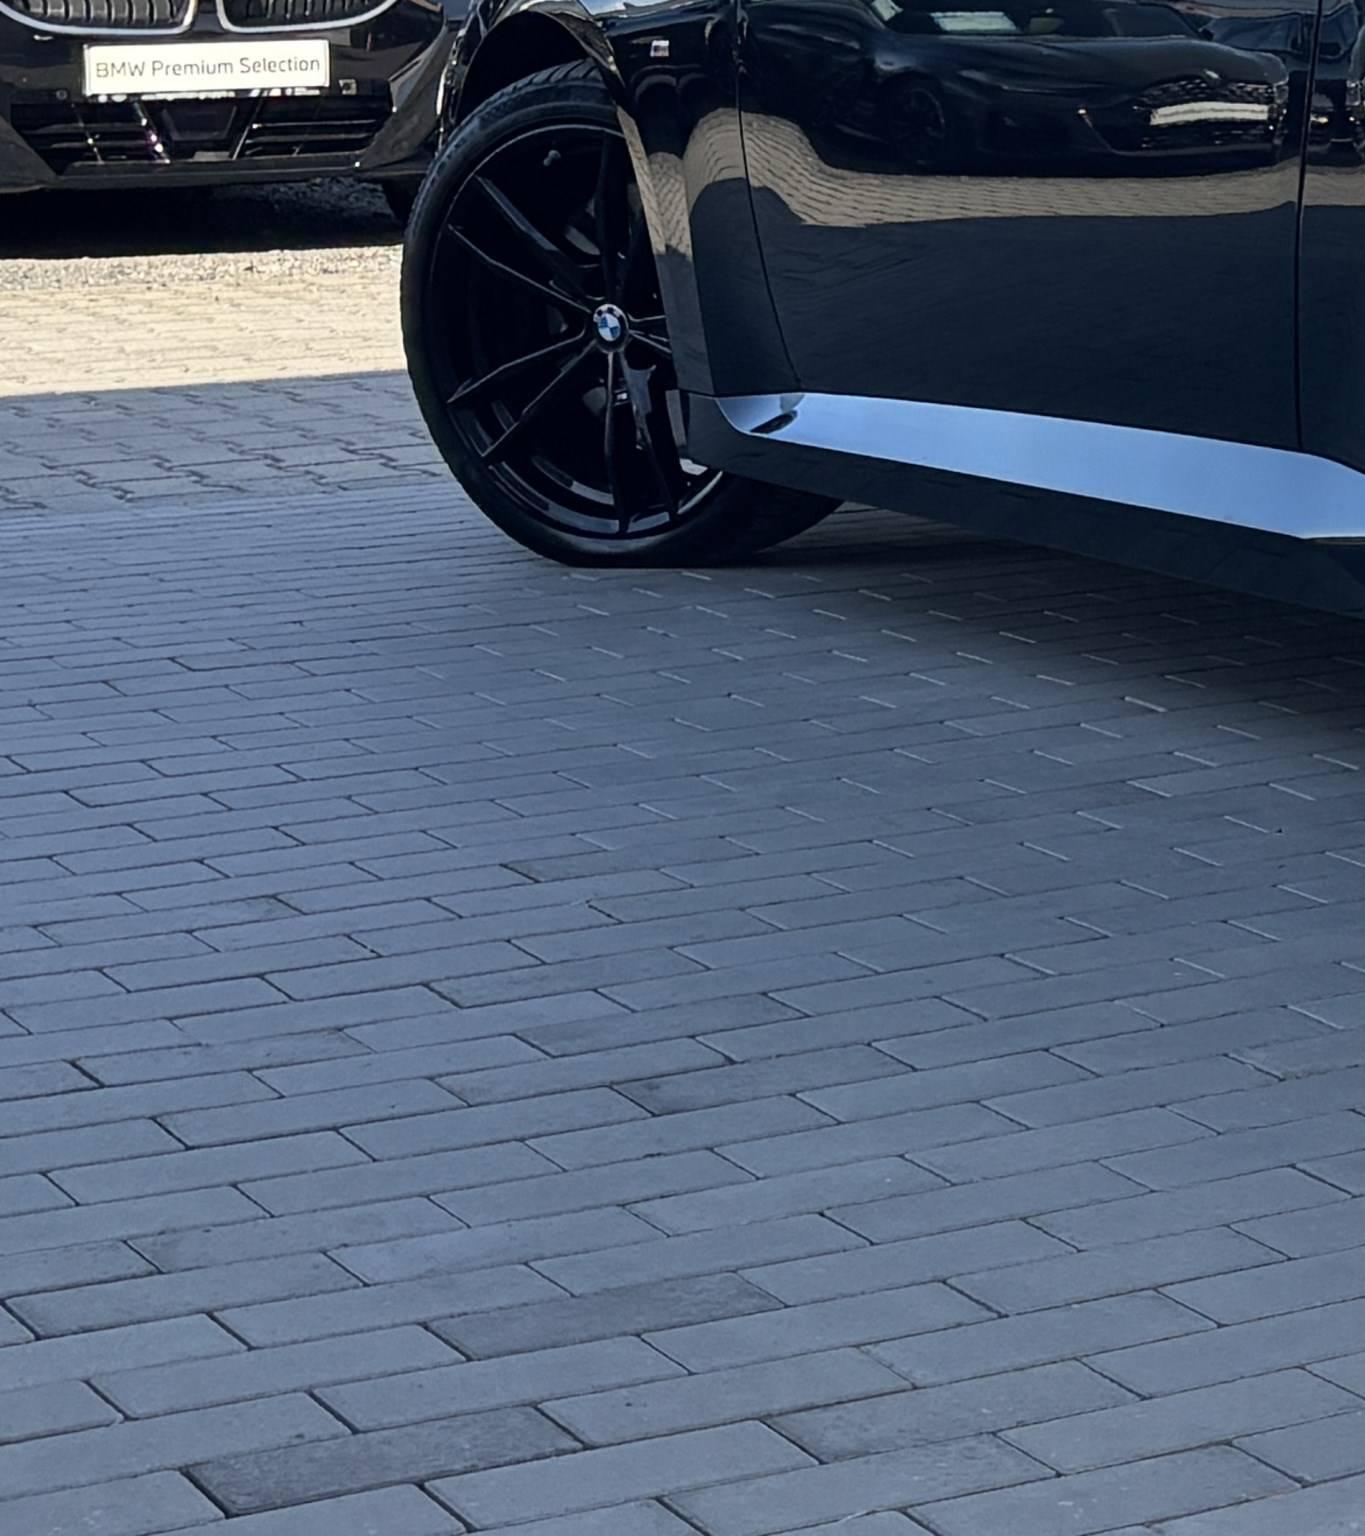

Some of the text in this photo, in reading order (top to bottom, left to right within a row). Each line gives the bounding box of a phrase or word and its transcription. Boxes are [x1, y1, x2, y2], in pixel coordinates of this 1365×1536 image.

[95, 56, 321, 79] BMW Premium Selection
